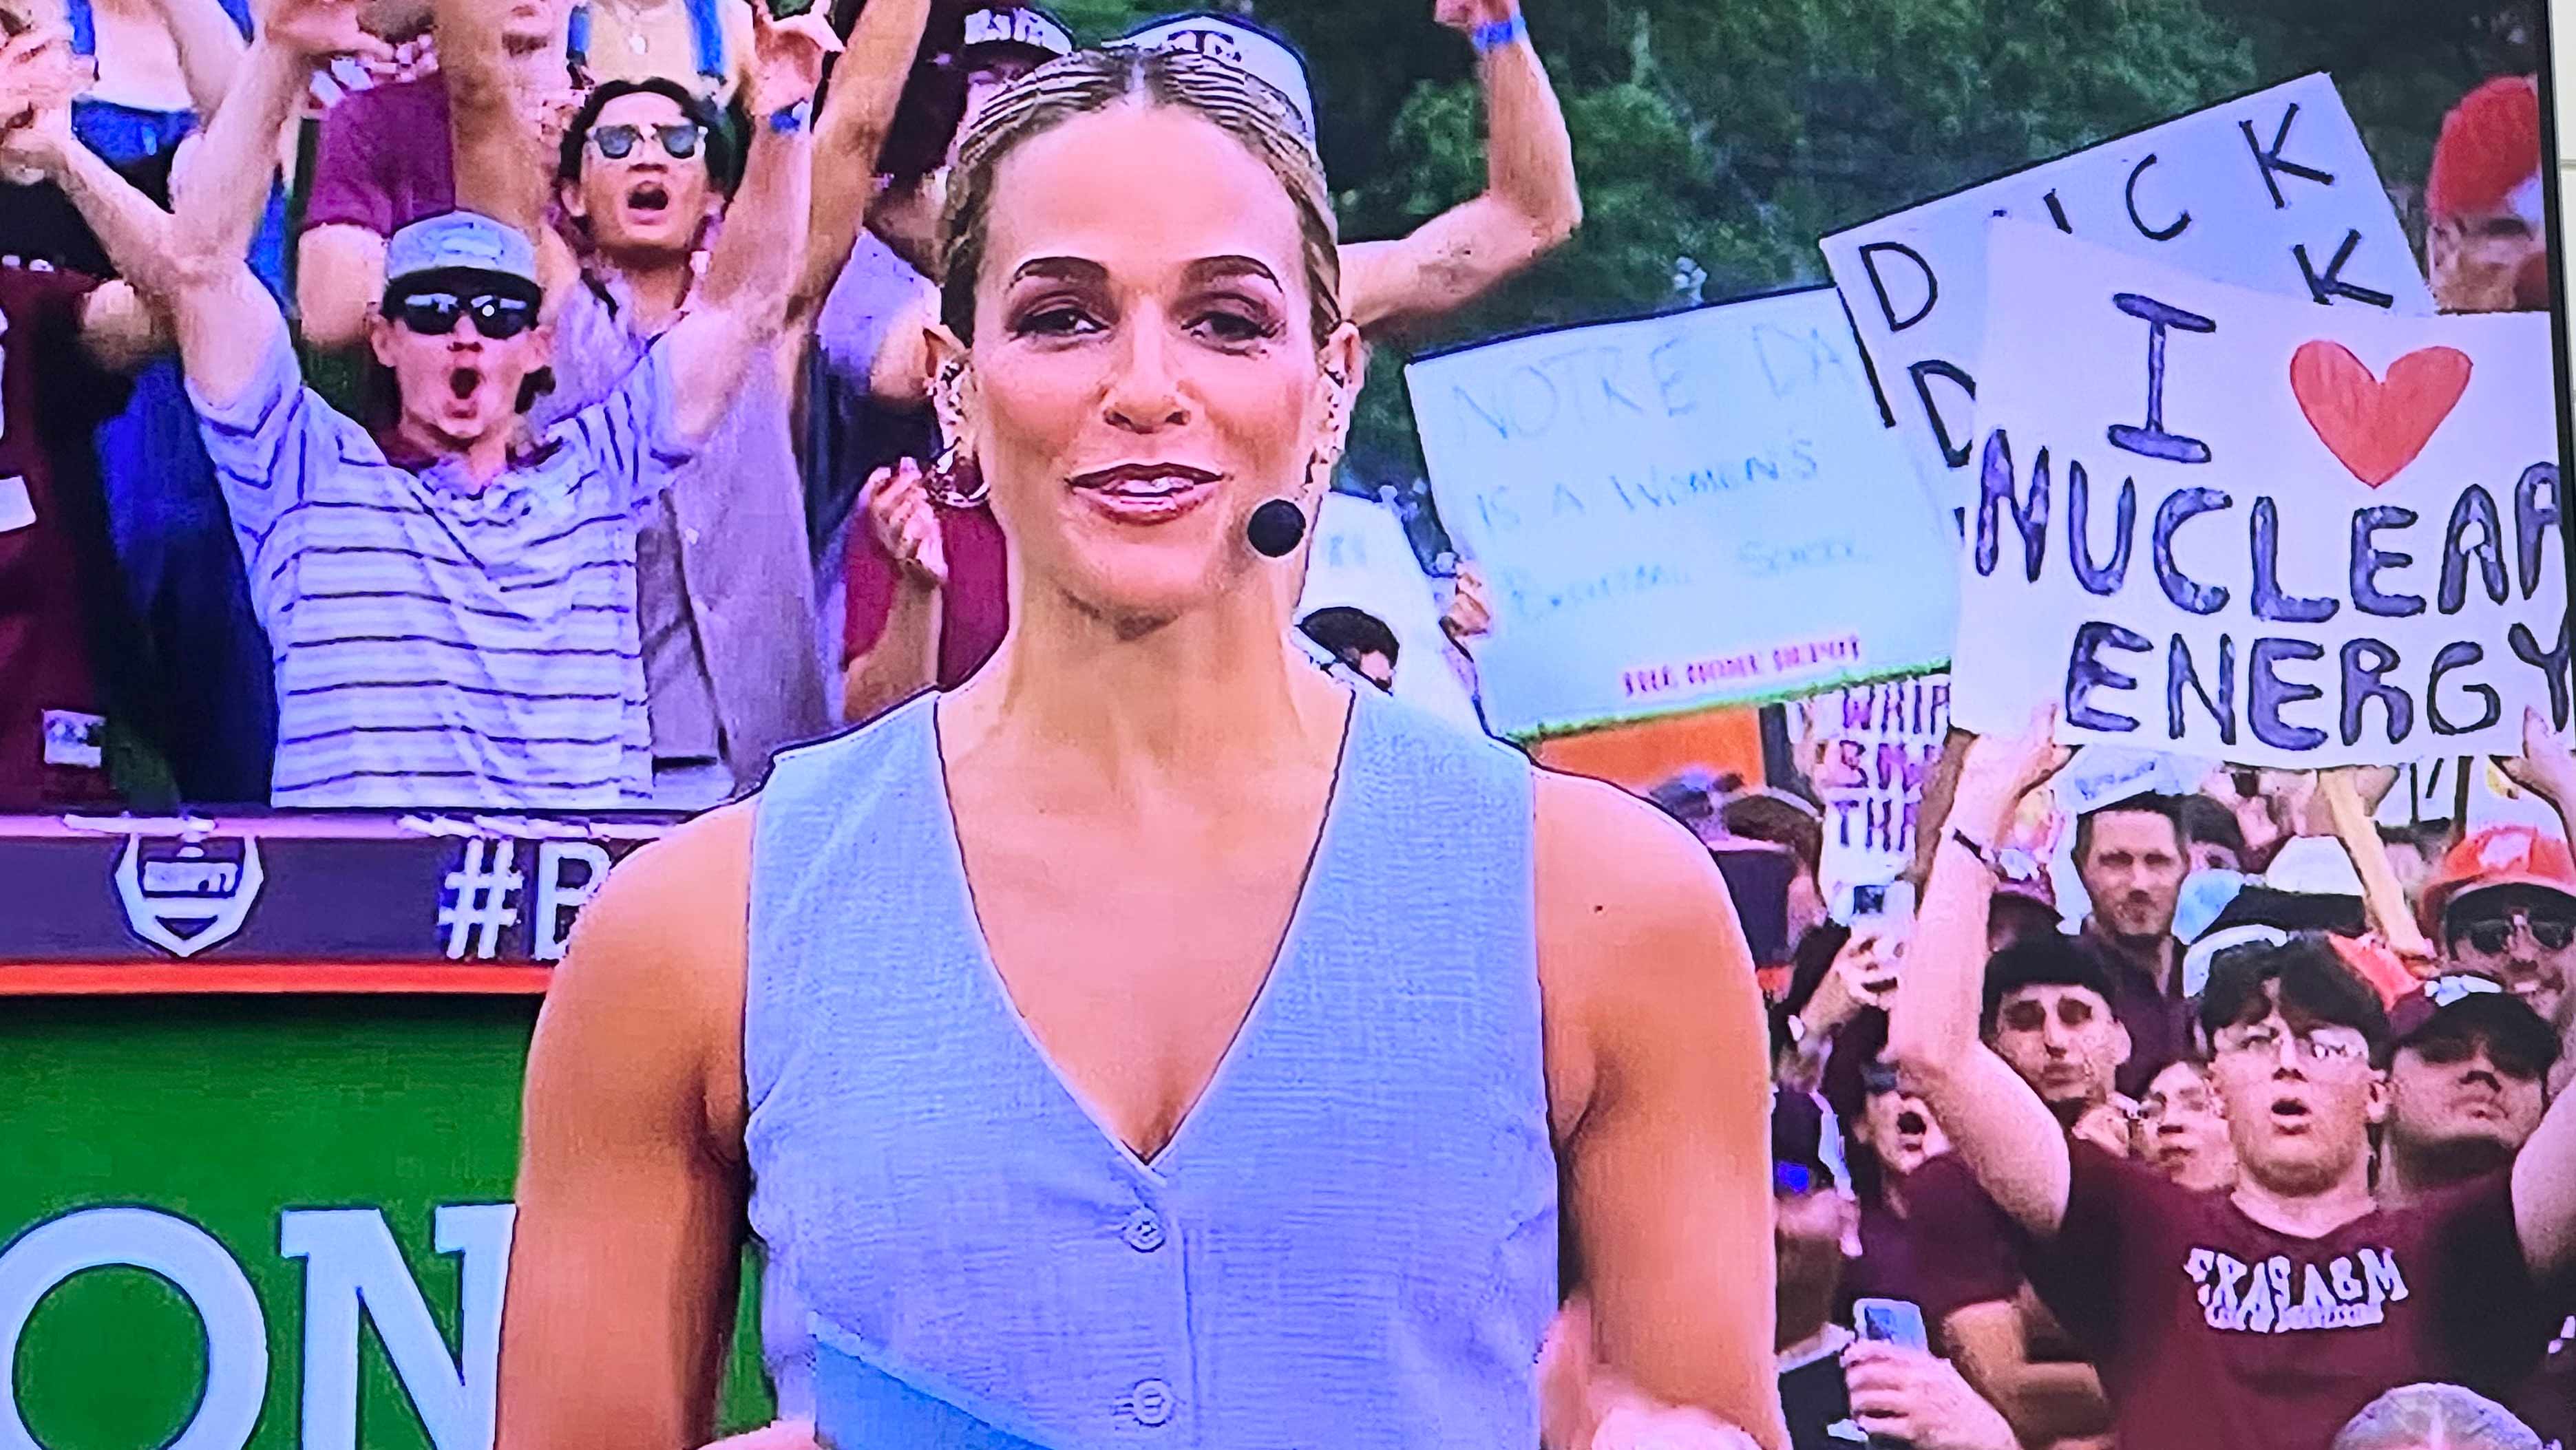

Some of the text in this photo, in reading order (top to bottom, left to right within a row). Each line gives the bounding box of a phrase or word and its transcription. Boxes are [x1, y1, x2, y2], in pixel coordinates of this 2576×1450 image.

[1450, 330, 1698, 446] NOTRE
[2107, 292, 2216, 463] I
[1476, 484, 1521, 529] IS
[1554, 483, 1585, 513] A
[2065, 607, 2571, 751] ENERGY
[0, 1204, 517, 1450] ON
